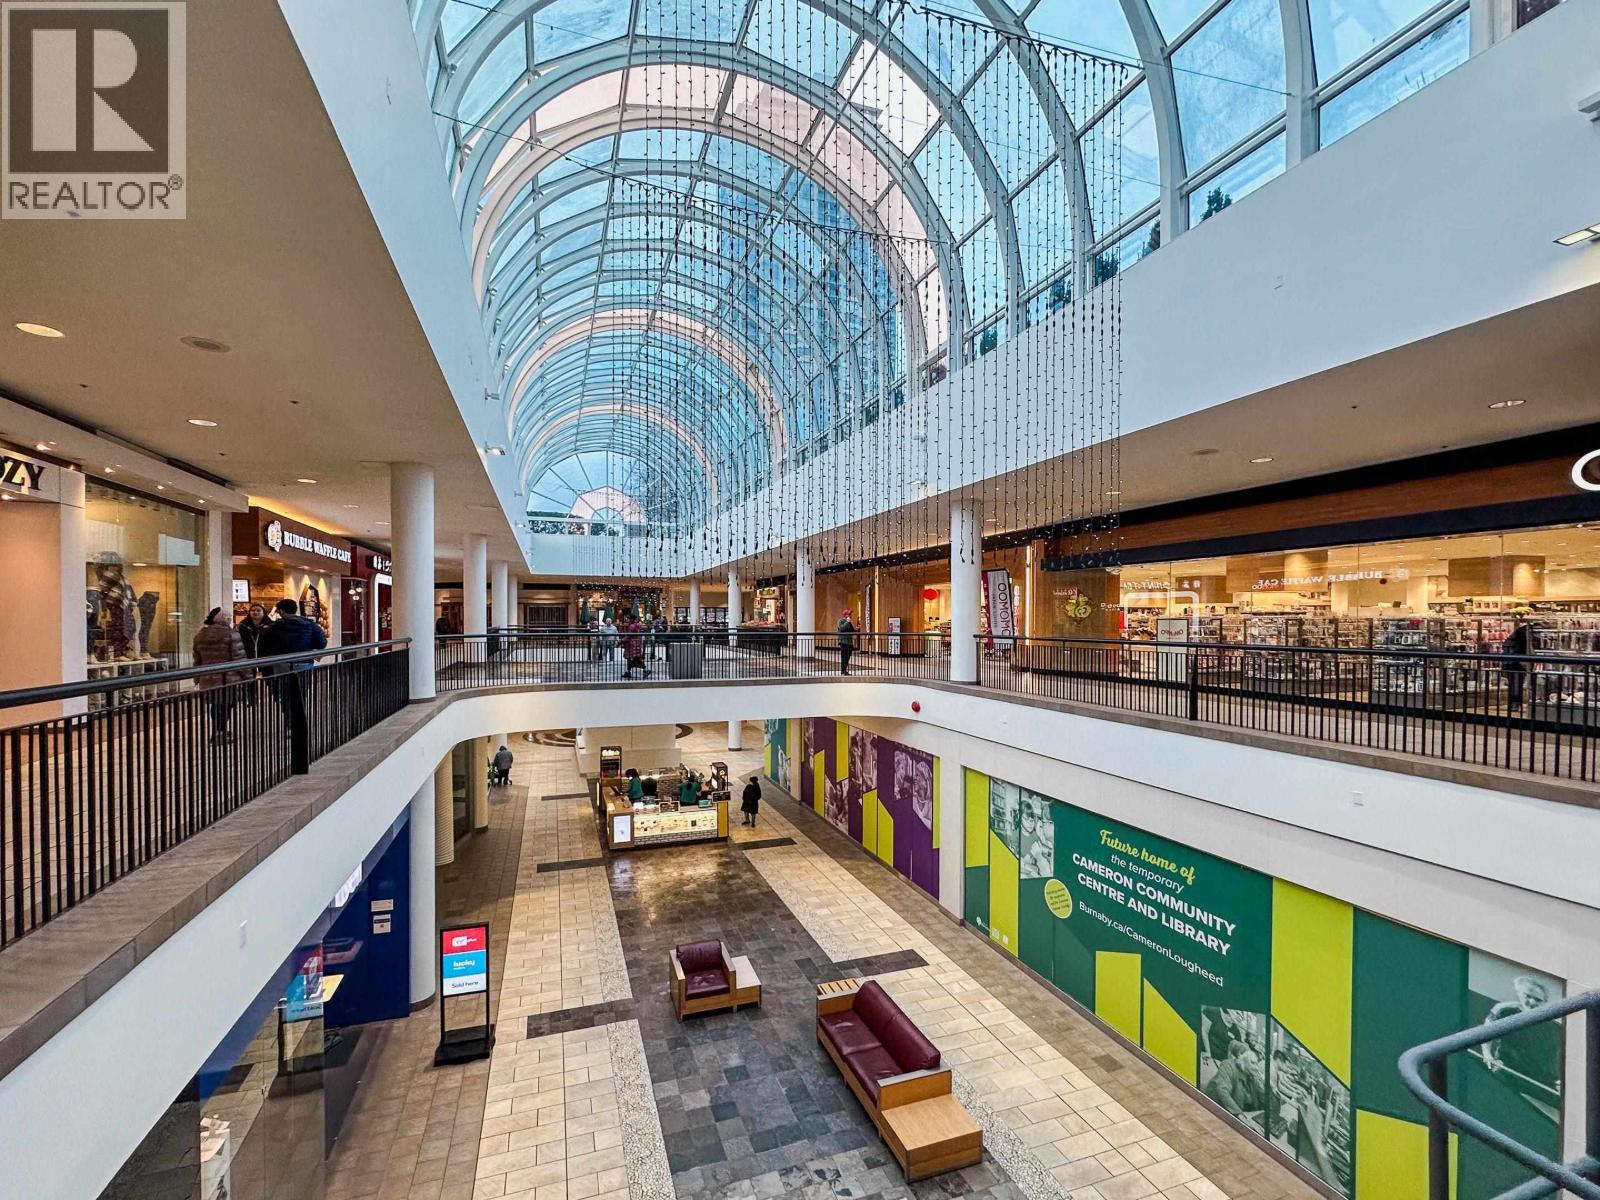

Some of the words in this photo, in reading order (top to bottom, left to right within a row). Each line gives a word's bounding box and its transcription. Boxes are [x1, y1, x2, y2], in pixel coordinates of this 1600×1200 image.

[283, 530, 313, 553] BUBBLE
[313, 540, 337, 560] WAFFLE
[1100, 829, 1140, 858] Future
[1141, 848, 1178, 873] home
[1180, 866, 1195, 885] of
[1111, 854, 1127, 868] the
[1129, 861, 1185, 894] temporary
[1072, 853, 1133, 890] CAMERON
[1136, 882, 1236, 937] COMMUNITY
[1078, 873, 1125, 905] CENTRE
[1127, 897, 1158, 921] AND
[1161, 912, 1231, 956] LIBRARY
[1079, 900, 1224, 987] Burnaby.ca/CameronLougheed
